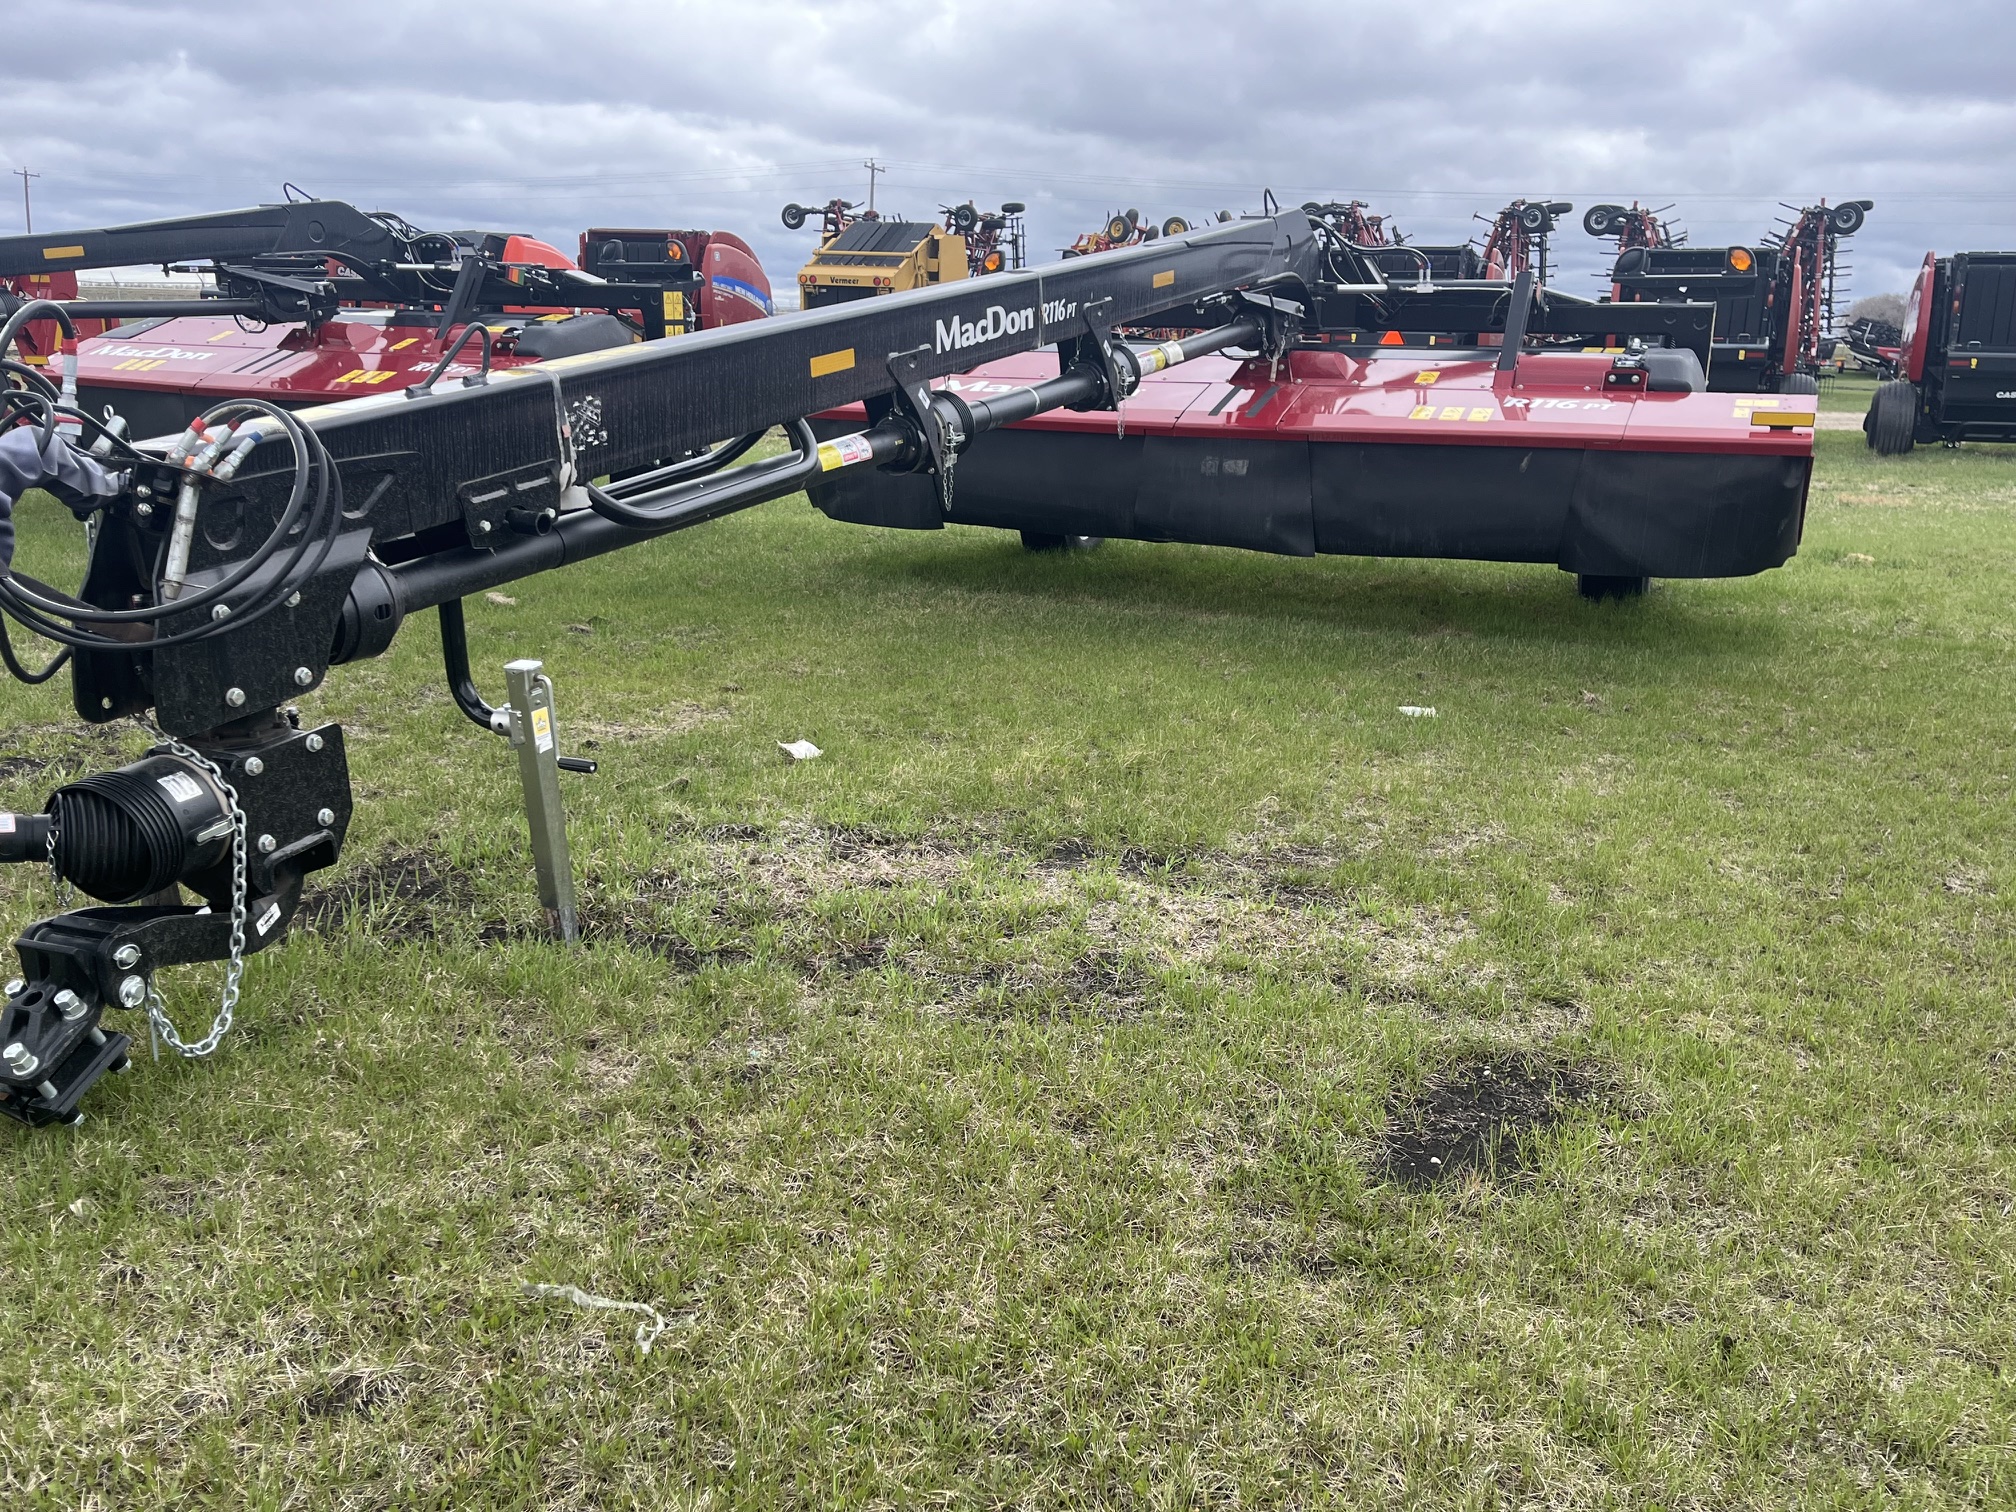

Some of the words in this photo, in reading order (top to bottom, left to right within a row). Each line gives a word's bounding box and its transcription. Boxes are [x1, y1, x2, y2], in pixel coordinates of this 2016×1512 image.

[830, 276, 859, 284] Vermeer
[936, 305, 1035, 354] MacDon
[1043, 298, 1066, 325] R116
[1066, 301, 1077, 319] PT
[89, 344, 216, 360] MacDon
[1503, 395, 1580, 409] R116
[1582, 403, 1617, 411] PT
